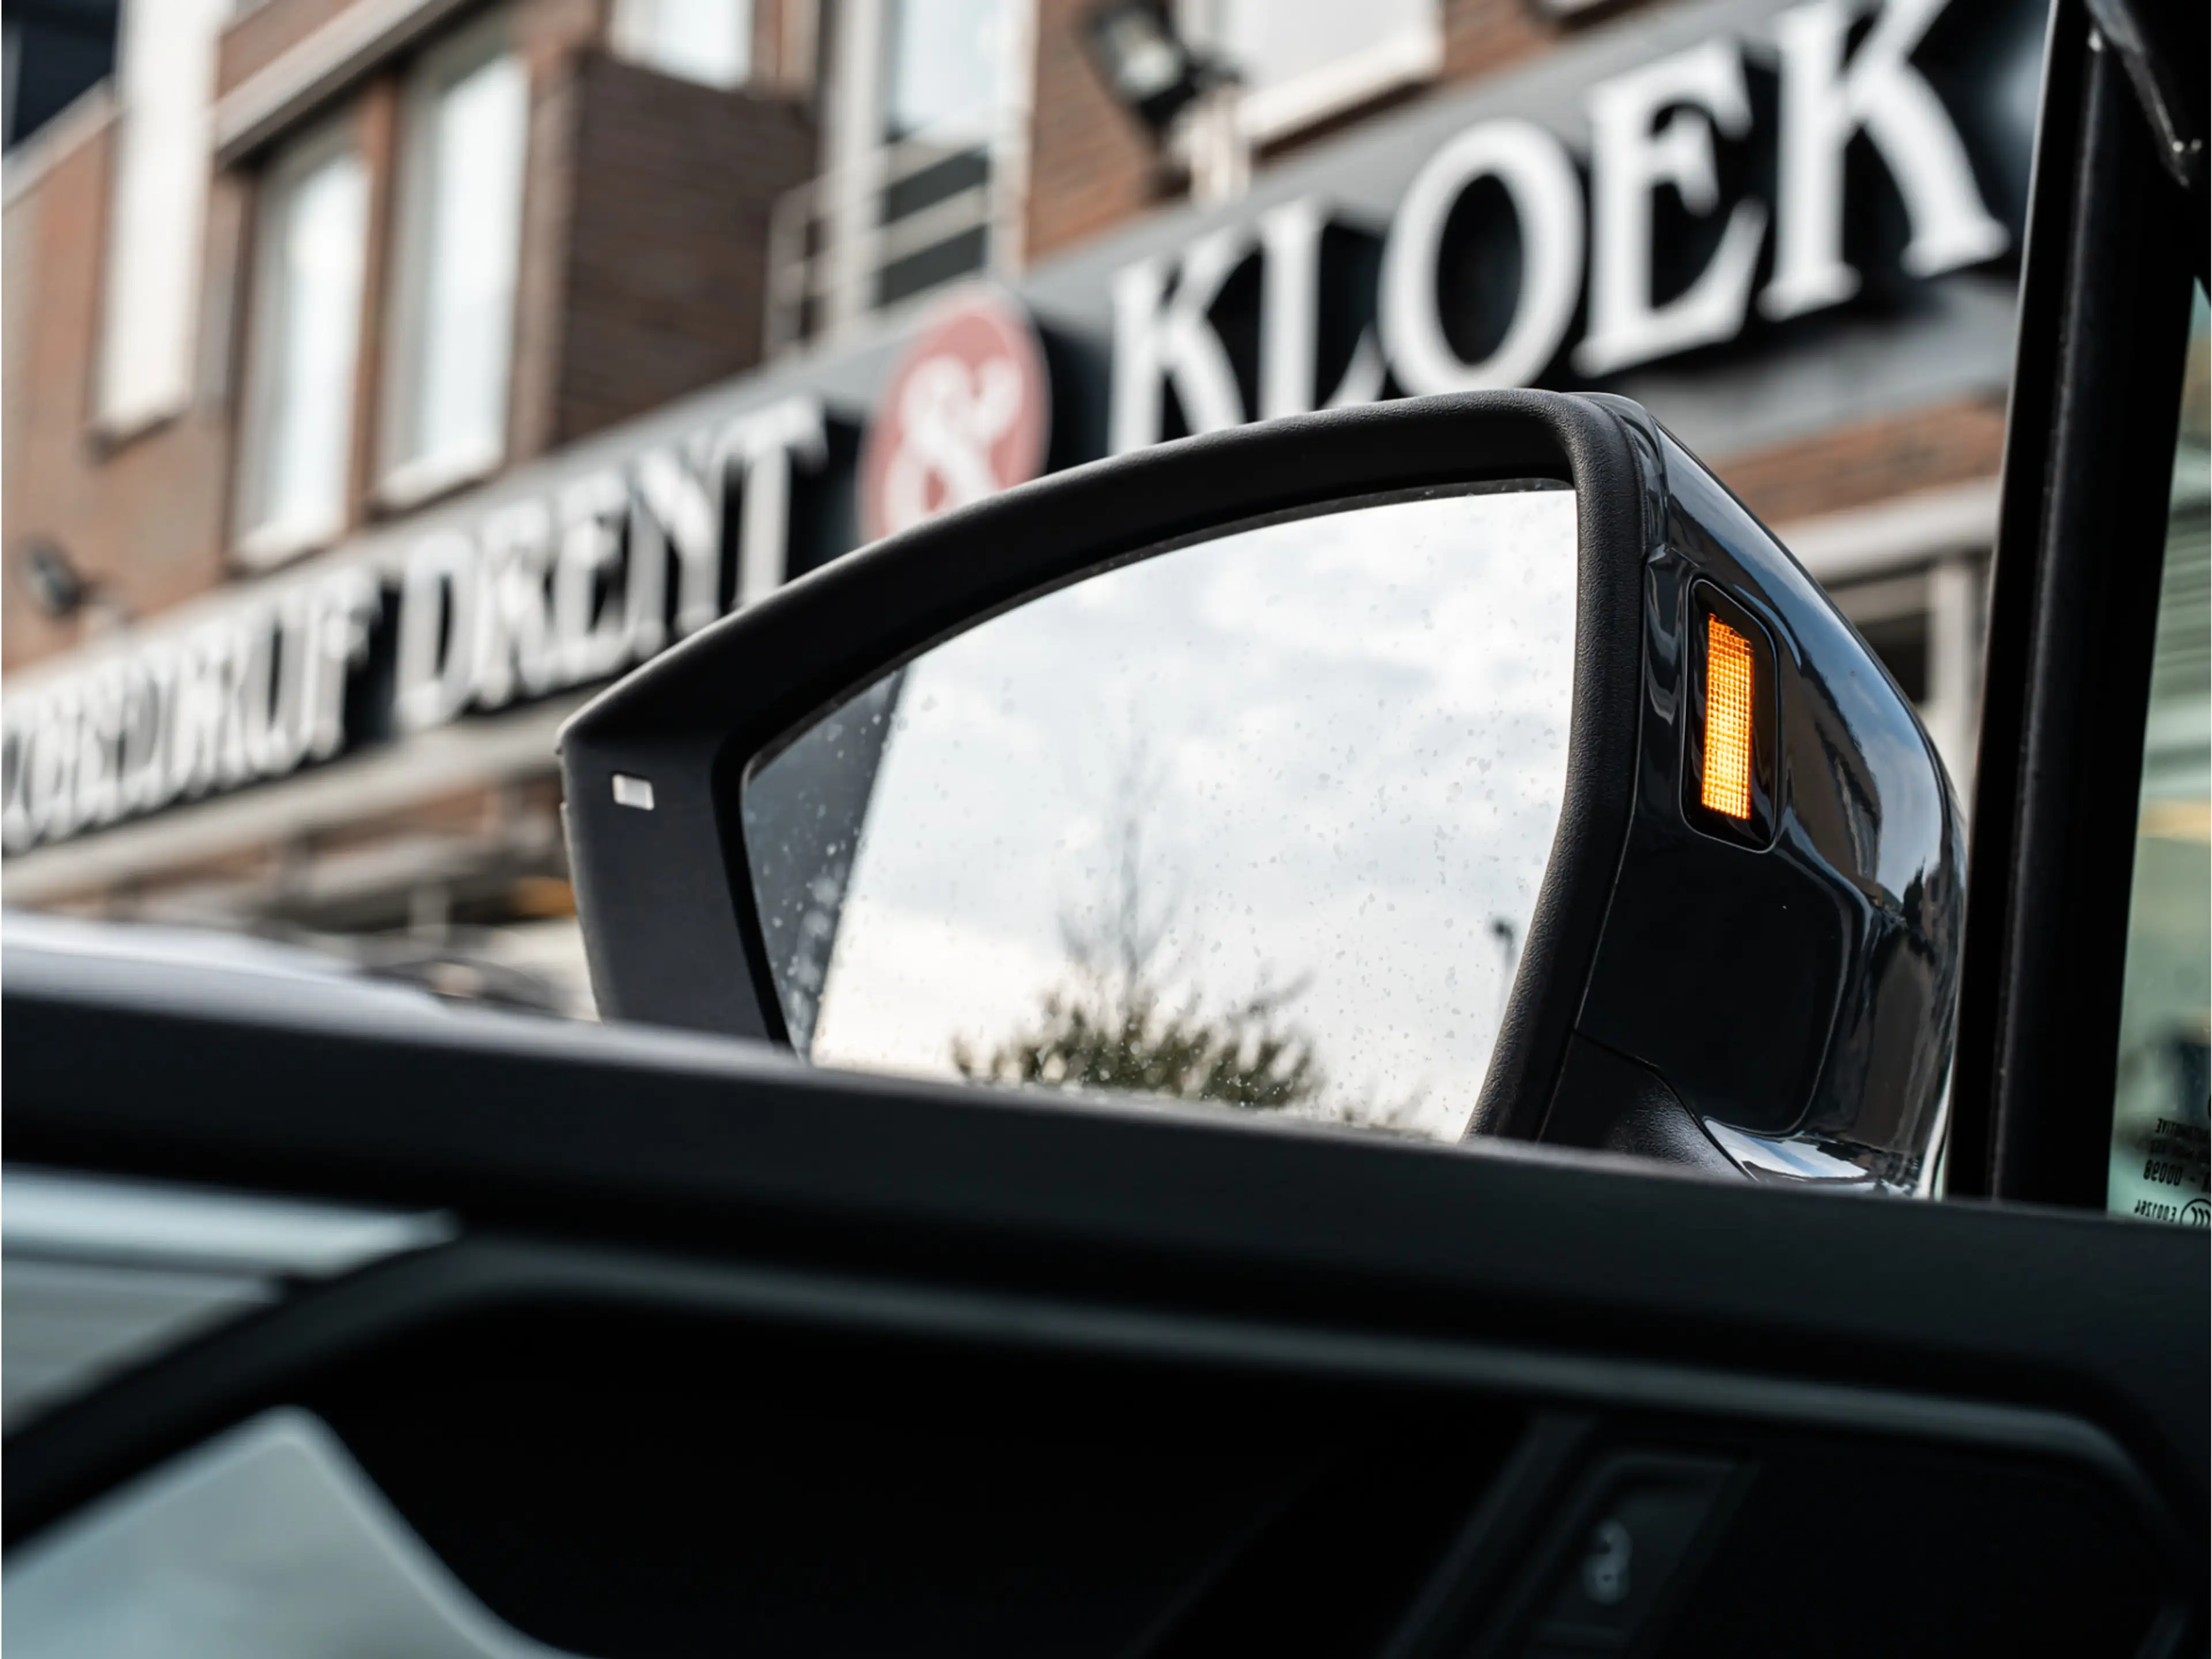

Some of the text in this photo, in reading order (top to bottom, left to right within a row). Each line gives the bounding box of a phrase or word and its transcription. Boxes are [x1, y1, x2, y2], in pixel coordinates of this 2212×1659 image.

[395, 396, 827, 728] DRENT
[886, 353, 1023, 535] &
[1107, 0, 2010, 460] KLOEK
